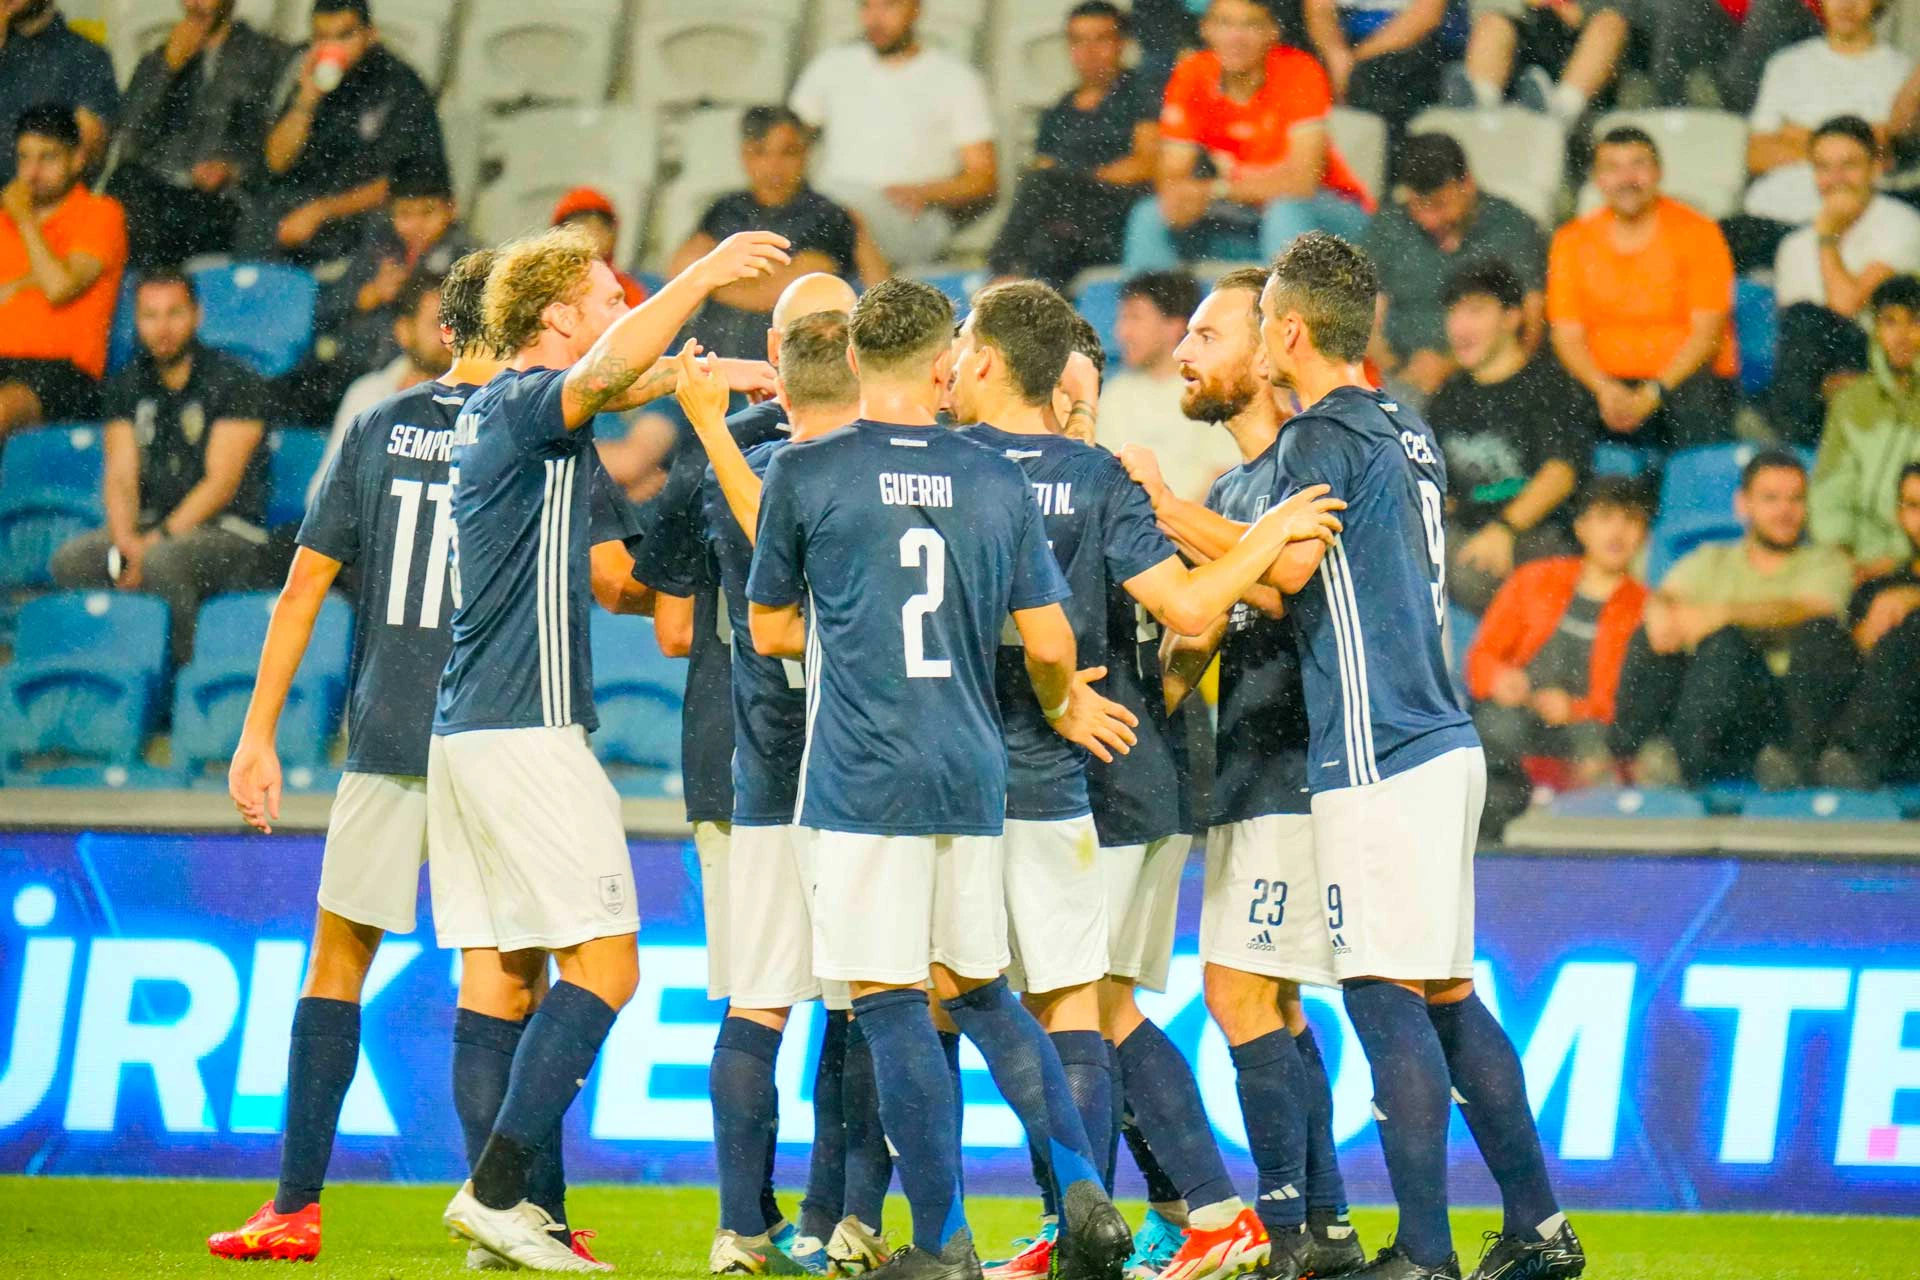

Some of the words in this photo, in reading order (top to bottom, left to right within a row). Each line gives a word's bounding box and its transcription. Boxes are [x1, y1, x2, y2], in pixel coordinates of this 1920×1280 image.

[879, 472, 953, 508] GUERRI
[386, 477, 452, 629] 11
[899, 527, 952, 678] 2
[1248, 878, 1288, 927] 23
[1327, 883, 1344, 930] 9
